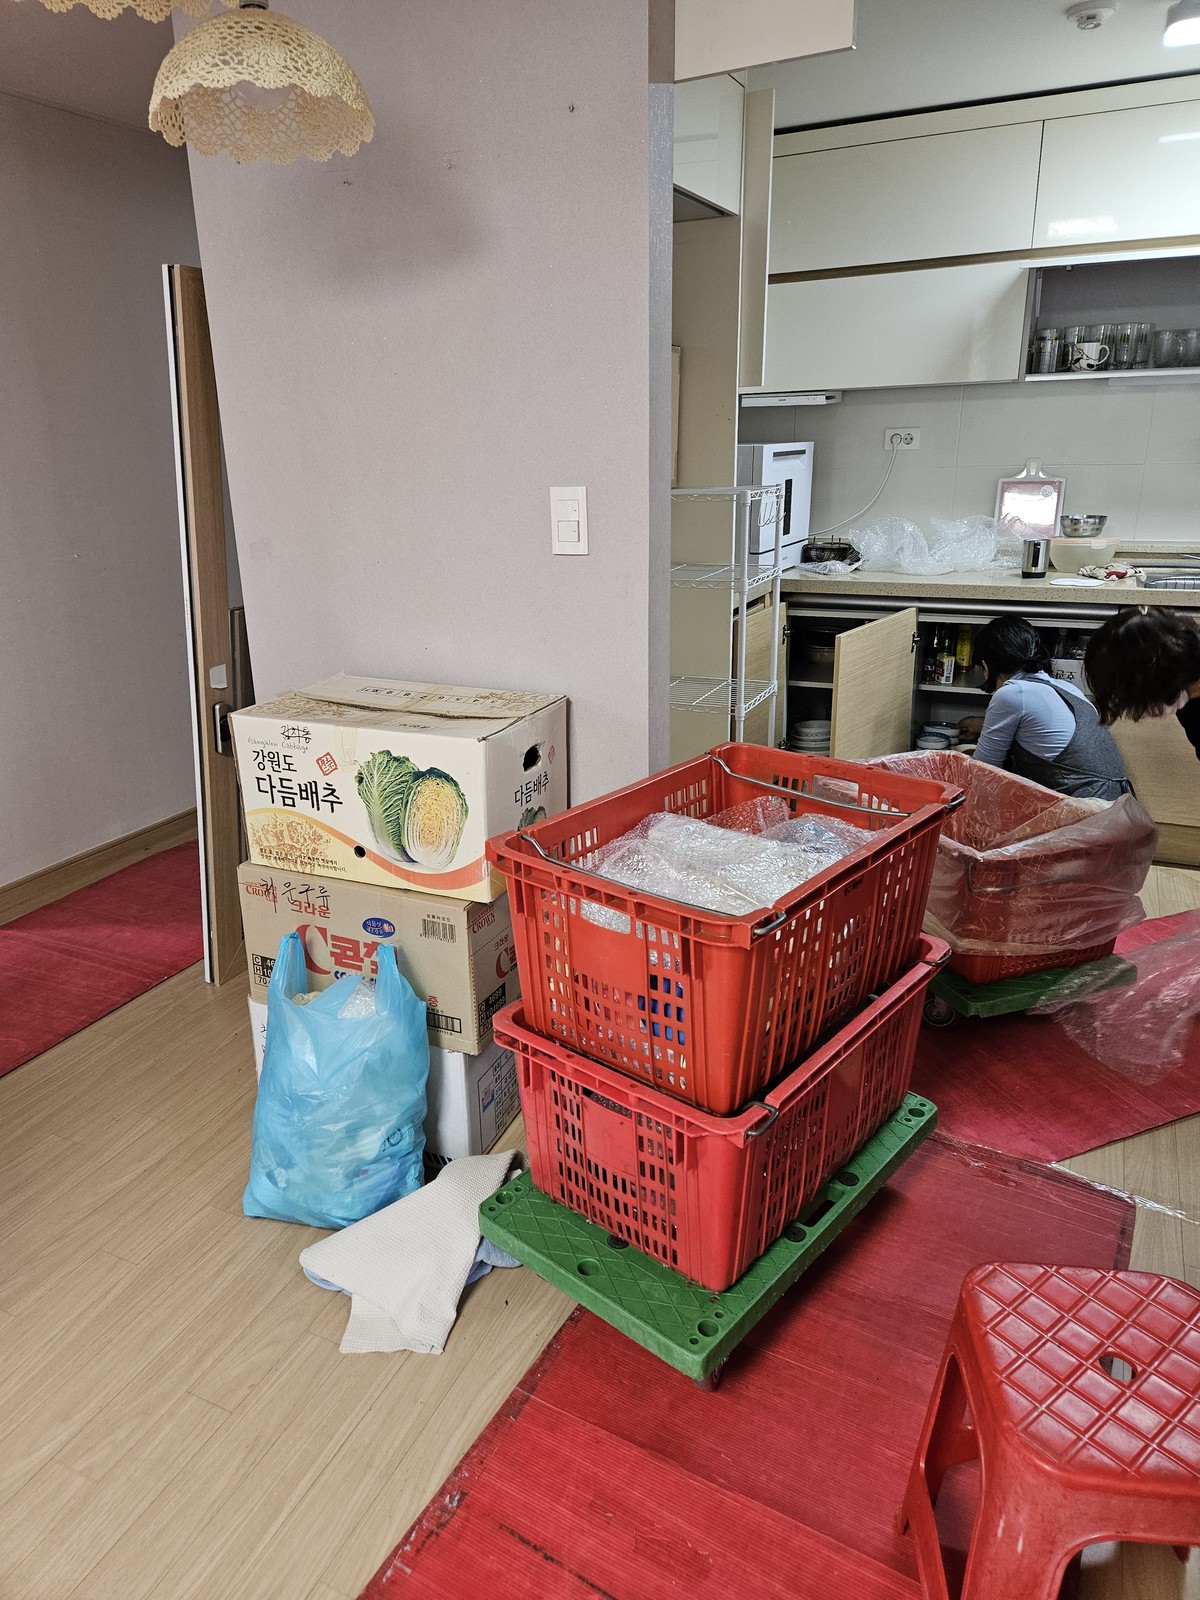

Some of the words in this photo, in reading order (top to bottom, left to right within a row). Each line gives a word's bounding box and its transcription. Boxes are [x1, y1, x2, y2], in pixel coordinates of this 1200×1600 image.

[252, 749, 298, 773] 강원도
[255, 774, 344, 814] 다듬배추
[514, 771, 550, 807] 다듬배추
[291, 900, 331, 919] 크라운
[472, 910, 496, 935] CROWN
